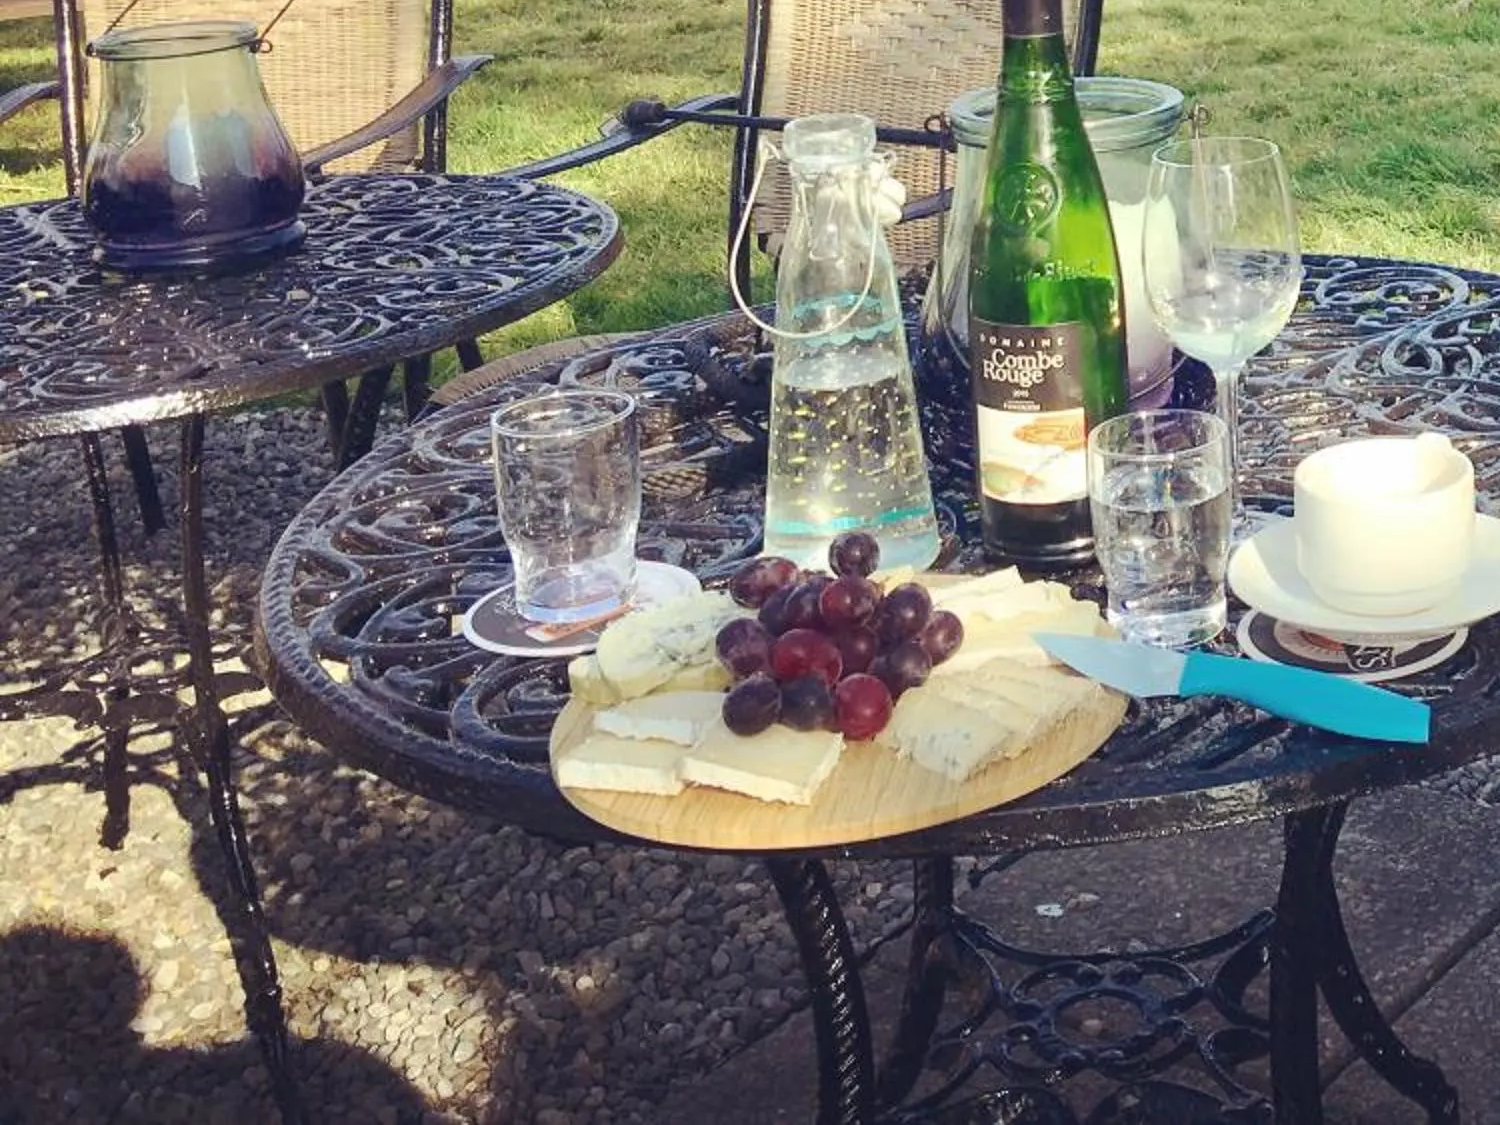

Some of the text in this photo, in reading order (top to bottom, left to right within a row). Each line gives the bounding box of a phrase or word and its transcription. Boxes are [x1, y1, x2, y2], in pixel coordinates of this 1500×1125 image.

[979, 332, 1065, 348] DOMAINE
[992, 348, 1064, 370] Combe
[983, 359, 1045, 388] Rouge
